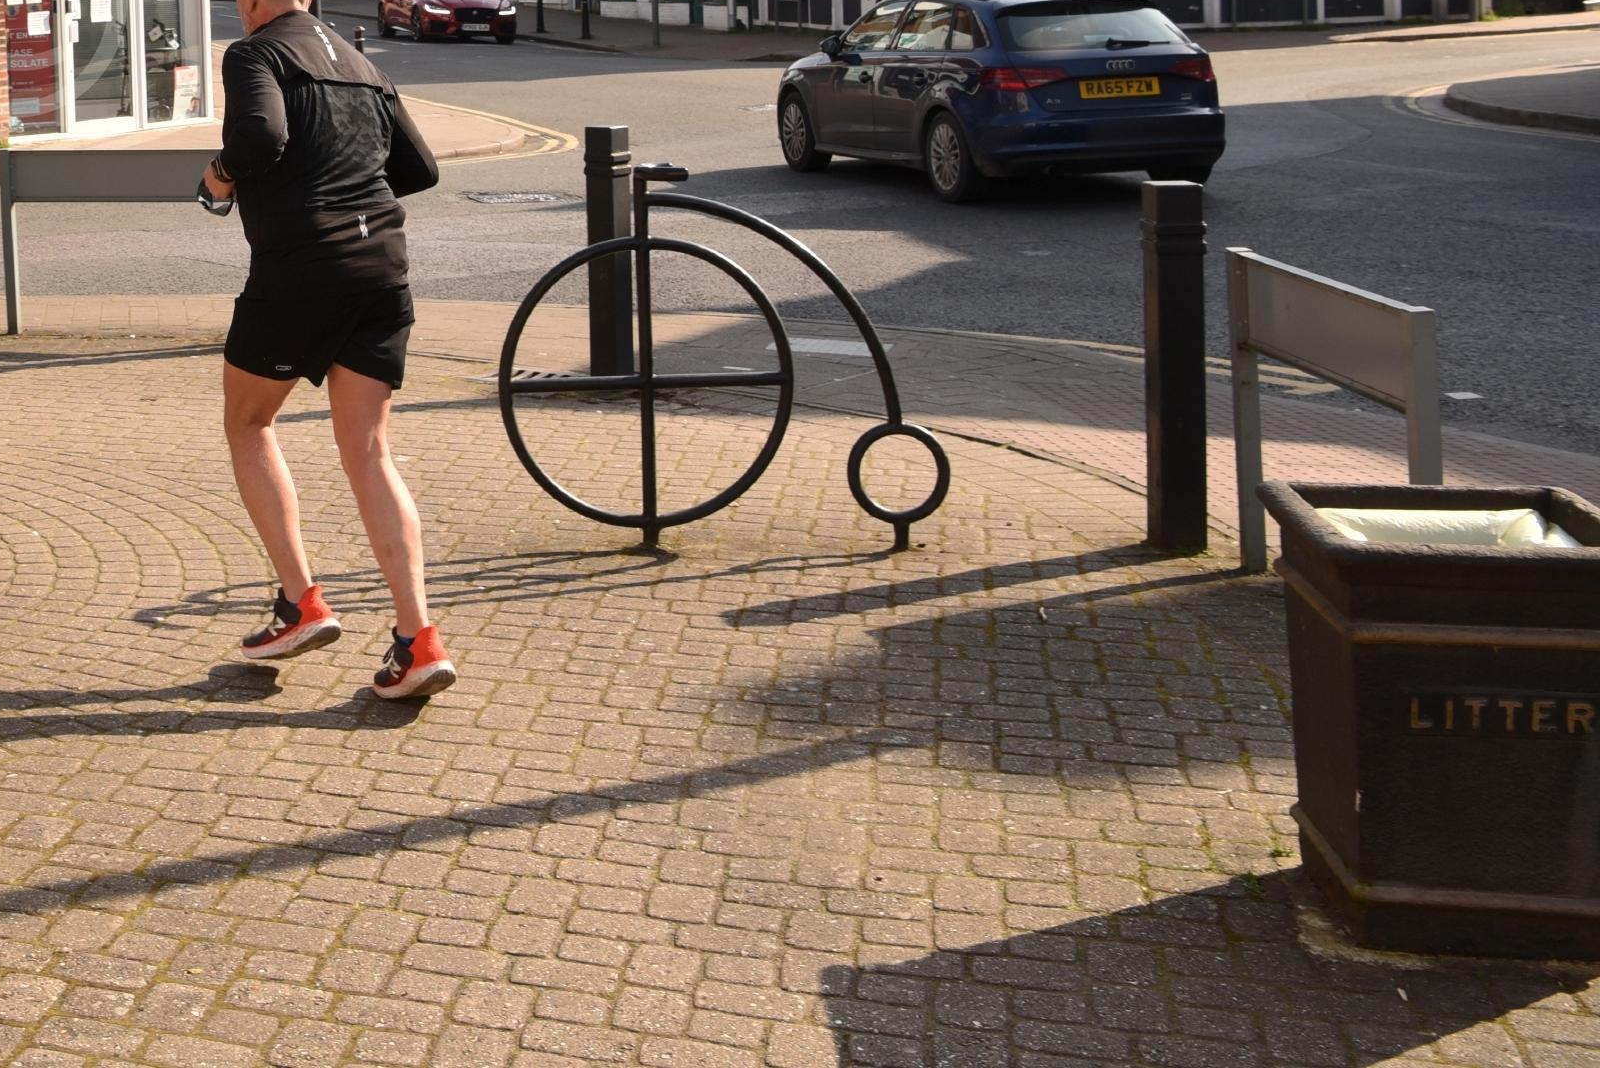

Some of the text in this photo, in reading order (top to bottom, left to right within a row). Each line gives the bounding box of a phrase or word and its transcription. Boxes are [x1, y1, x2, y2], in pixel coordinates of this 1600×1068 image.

[1085, 79, 1154, 96] RA65 FZW
[1409, 696, 1596, 734] LITTER
